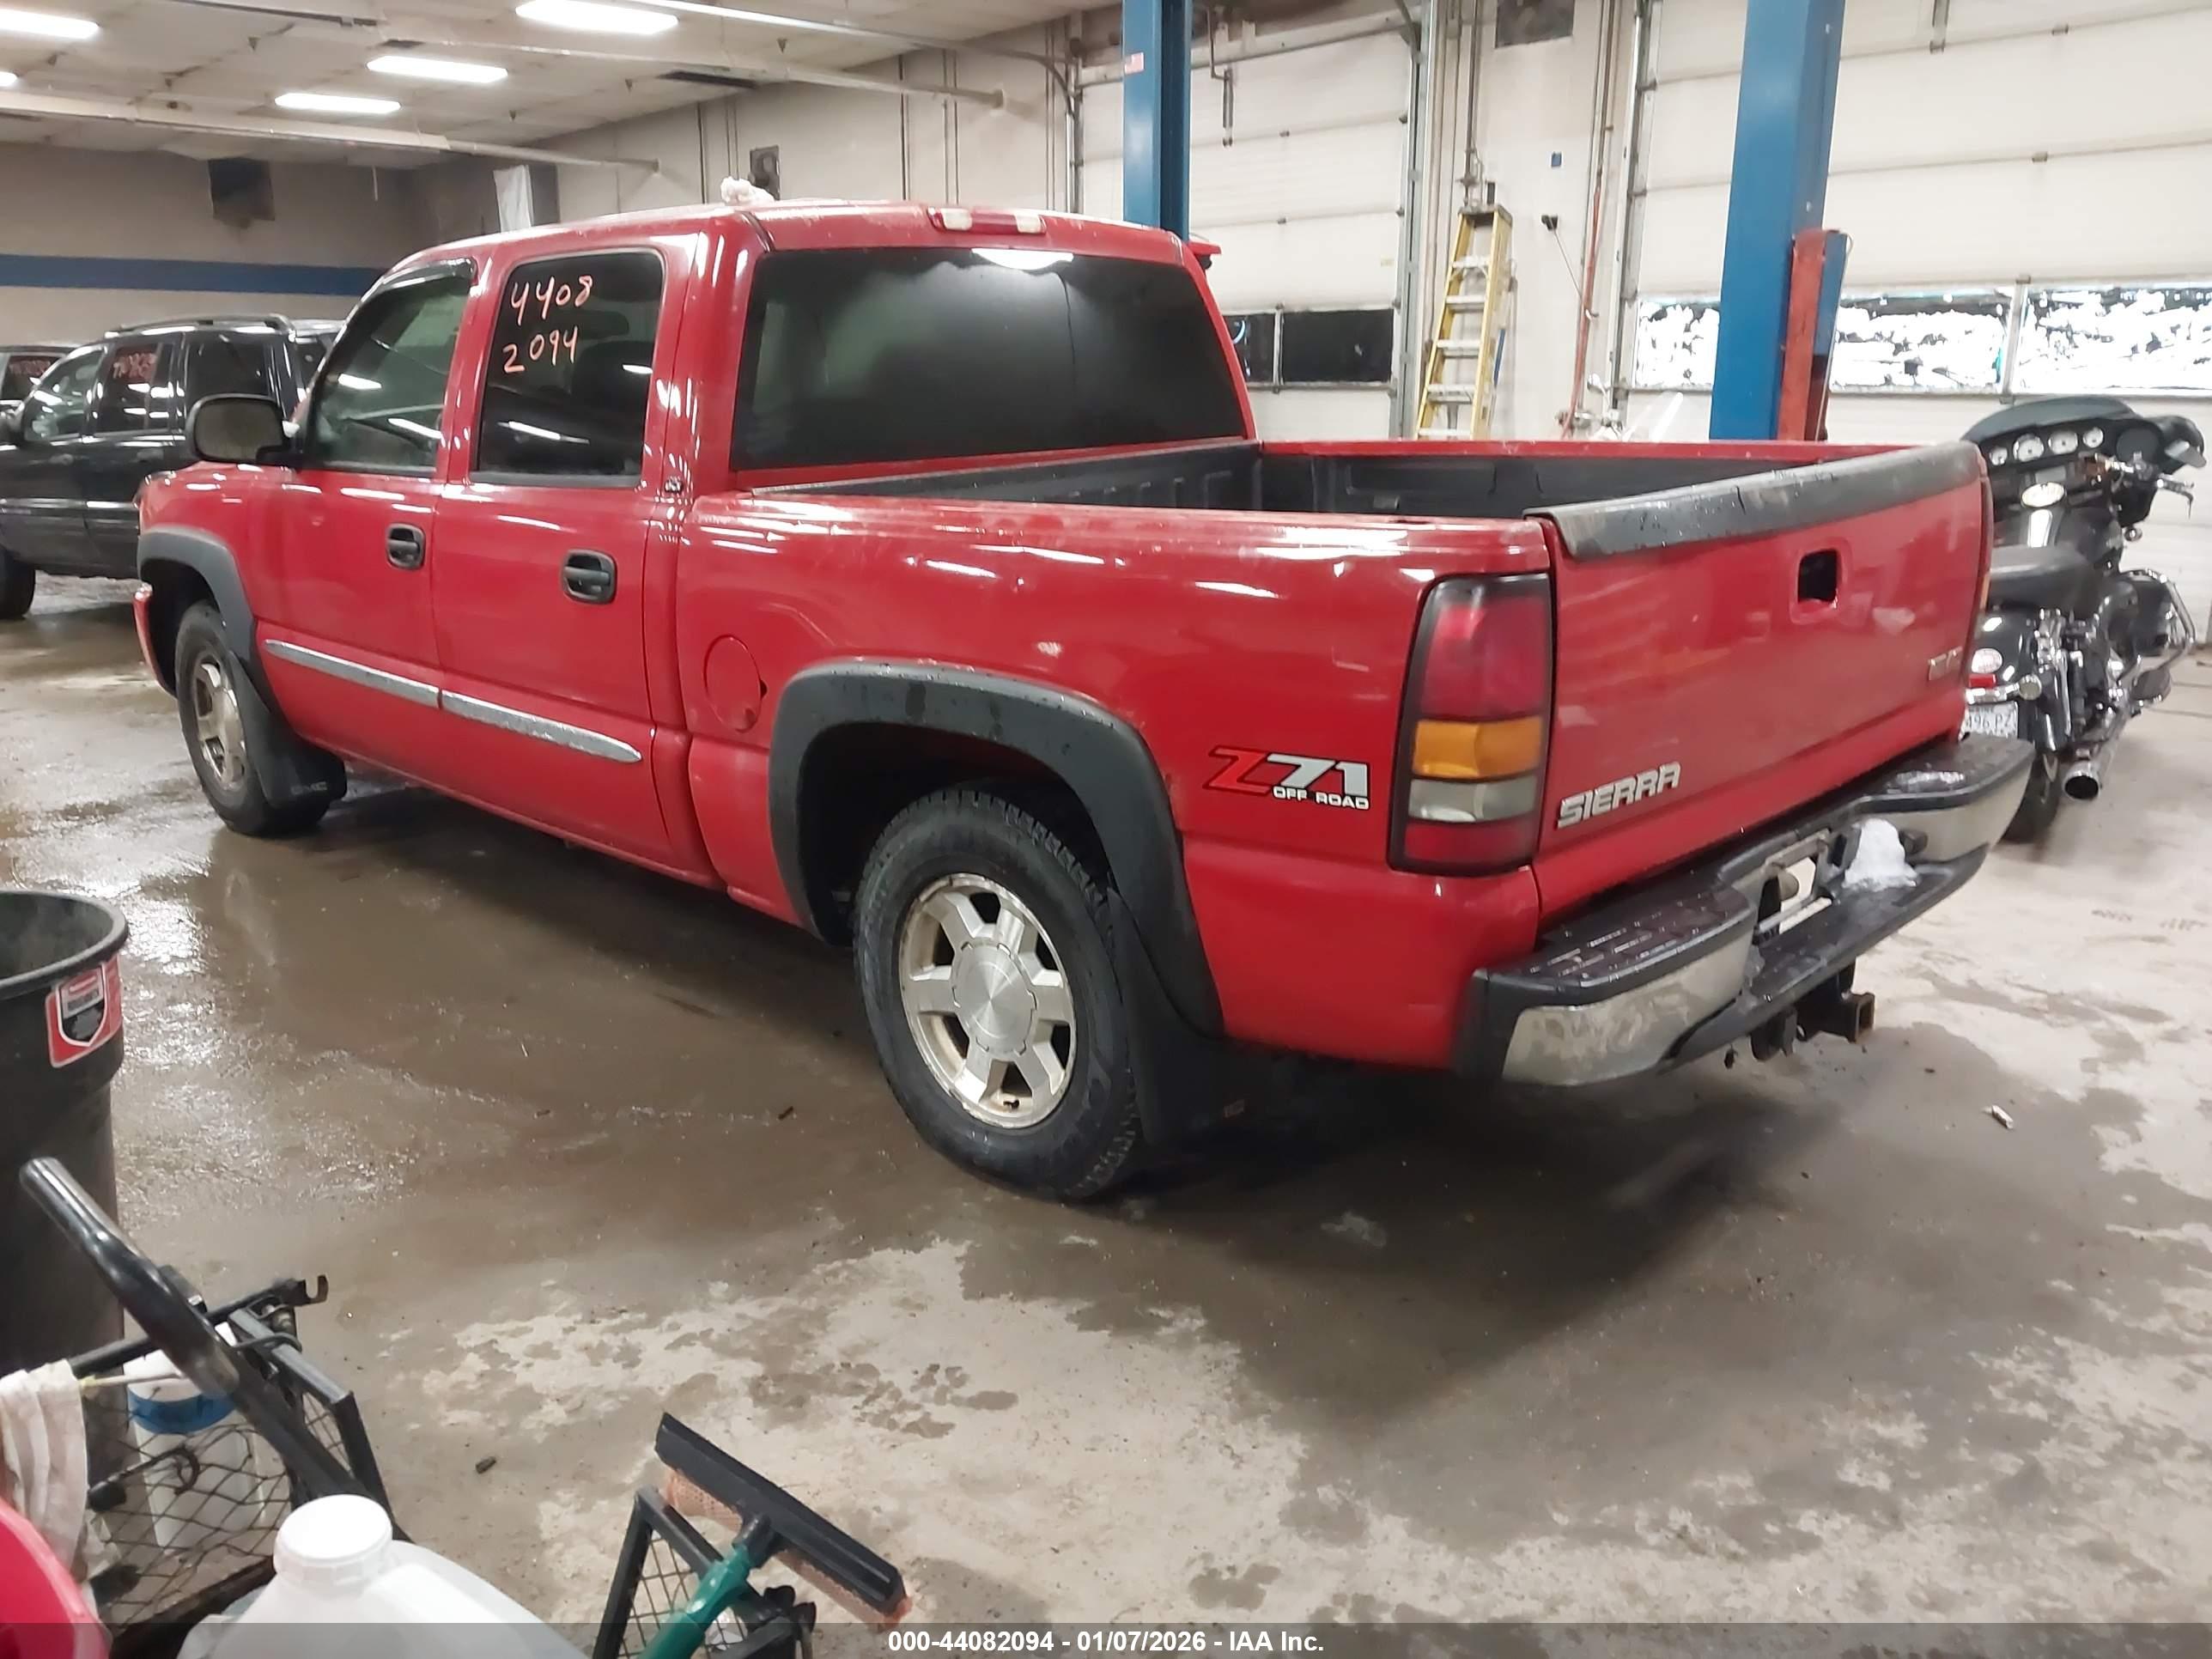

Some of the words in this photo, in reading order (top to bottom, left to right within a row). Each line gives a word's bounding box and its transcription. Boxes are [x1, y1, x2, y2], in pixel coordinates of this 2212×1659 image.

[510, 275, 593, 326] 4408
[501, 325, 579, 374] 2094
[1203, 744, 1370, 798] Z71
[1557, 761, 1681, 830] SIERRA
[1273, 785, 1308, 802] OFF
[1316, 791, 1370, 811] ROAD
